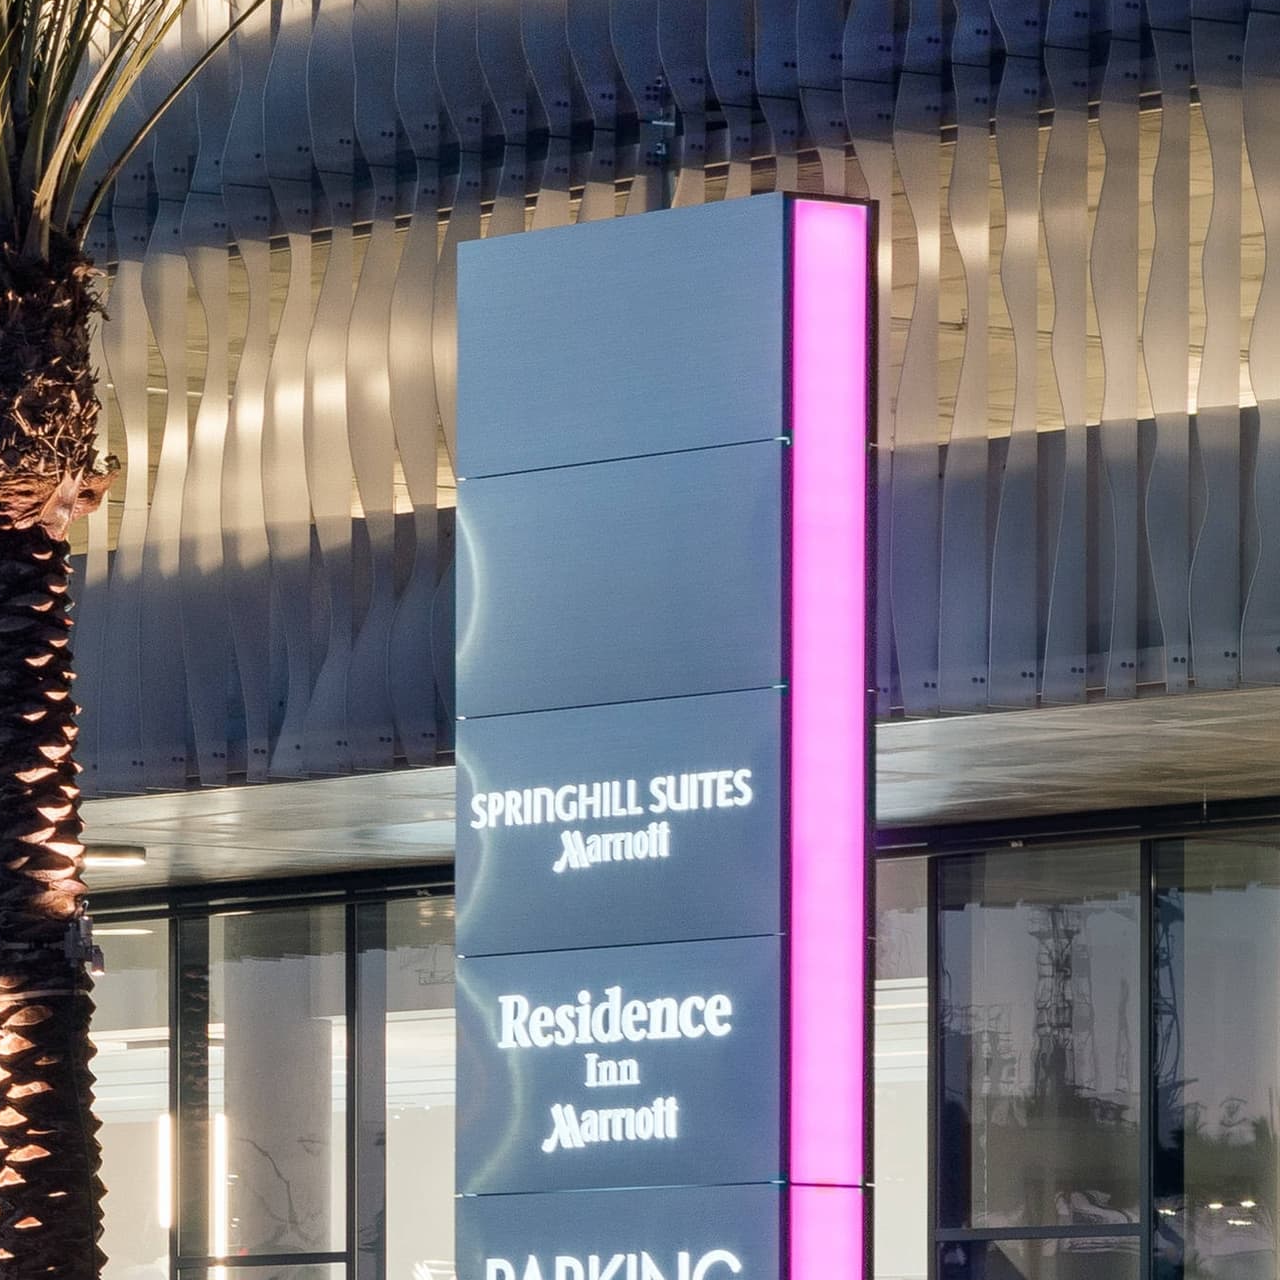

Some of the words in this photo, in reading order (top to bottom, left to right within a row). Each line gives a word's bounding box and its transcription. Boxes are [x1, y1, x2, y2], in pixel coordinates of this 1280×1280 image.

[470, 779, 644, 830] SPRINGHILL
[649, 768, 753, 814] SUITES
[552, 821, 671, 874] Marriott
[497, 986, 733, 1050] Residence
[584, 1053, 641, 1088] Inn
[541, 1096, 679, 1154] Marriott
